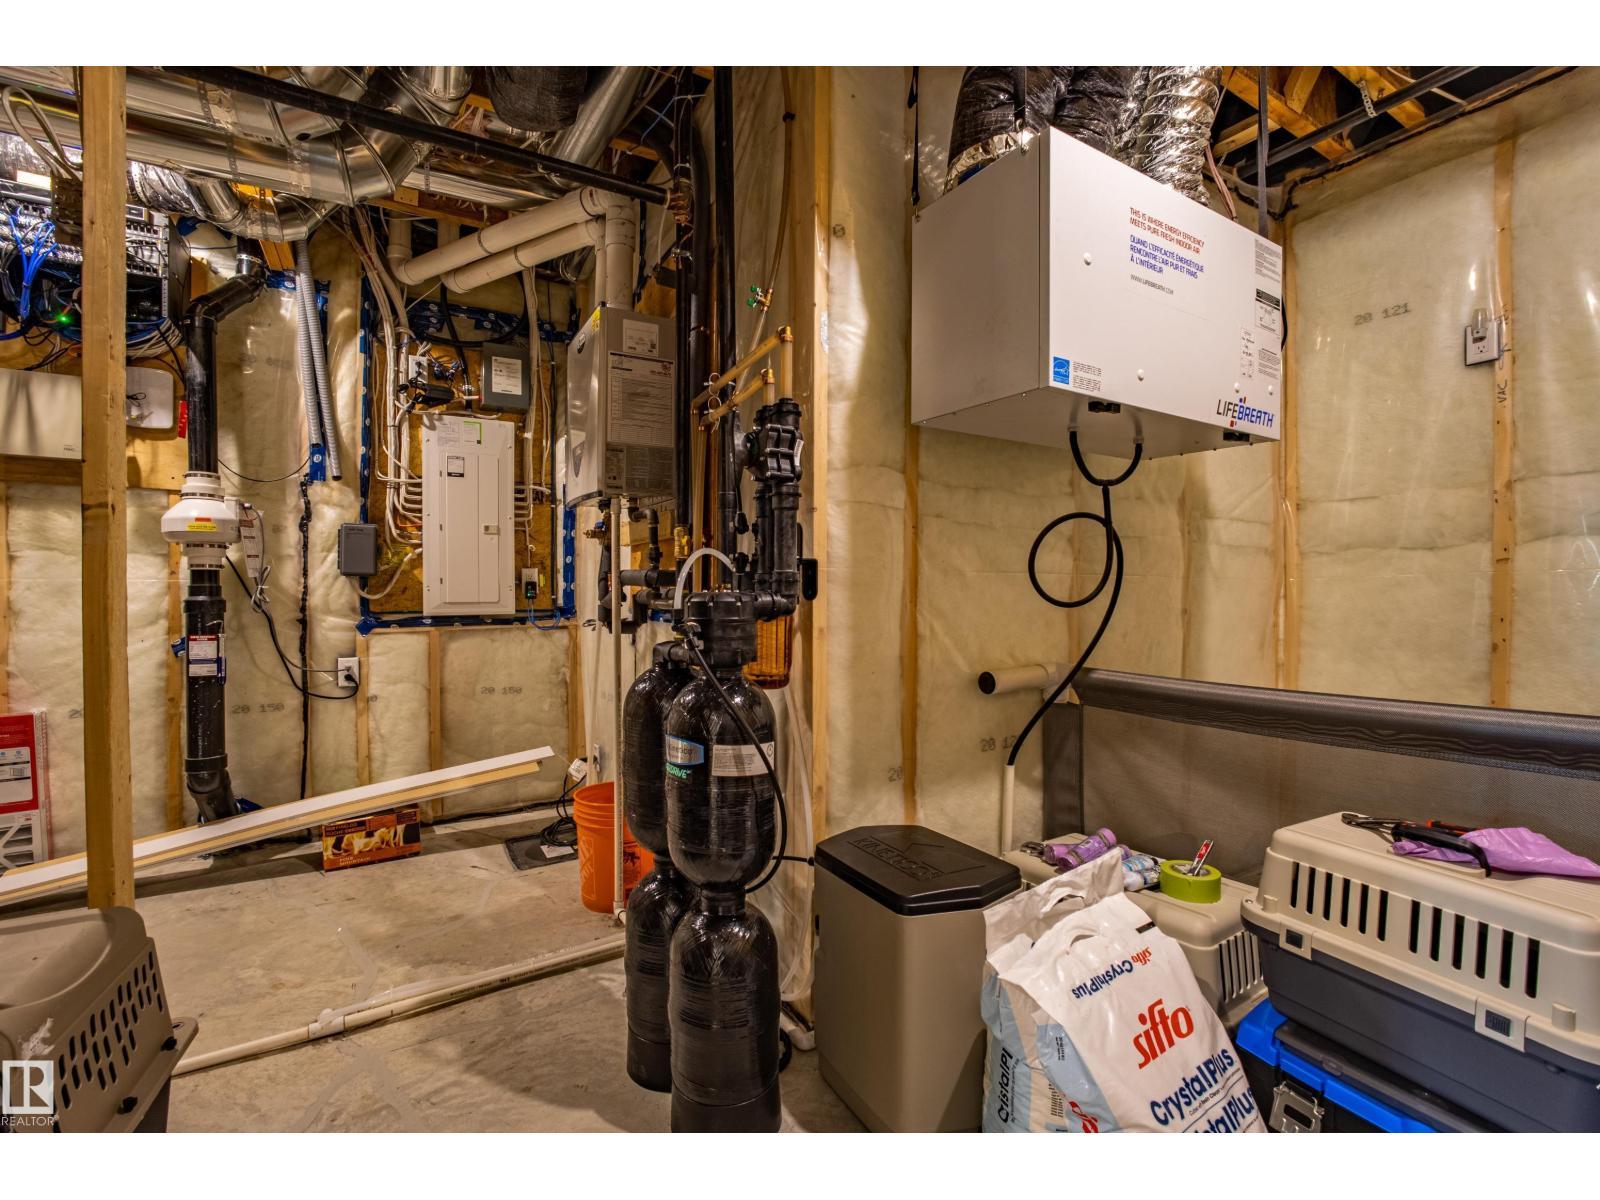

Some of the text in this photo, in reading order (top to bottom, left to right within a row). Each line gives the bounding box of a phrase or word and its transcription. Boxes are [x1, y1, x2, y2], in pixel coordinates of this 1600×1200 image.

[1130, 207, 1141, 218] THIS
[1148, 215, 1164, 229] WHERE
[1165, 223, 1181, 237] ENERGY
[1182, 231, 1205, 248] EFFICIENCY
[1130, 217, 1201, 254] MEETS PURE FRESH INDOOR AIR
[1130, 234, 1204, 272] QUAND L'EFFICACITÉ ÉNERGÉTIQUE
[1130, 245, 1158, 262] RENCONTRE
[1158, 256, 1169, 268] L'AIR
[1170, 261, 1179, 271] PUR
[1186, 268, 1198, 279] FRAIS
[1135, 256, 1164, 275] L'INTÉRIEUR
[1354, 302, 1412, 326] 20 121
[1216, 399, 1275, 428] LIFEBREATH
[1071, 947, 1152, 999] sifto CrystalPlus
[1133, 998, 1194, 1070] sifto
[1150, 1048, 1235, 1126] CrystalPlus
